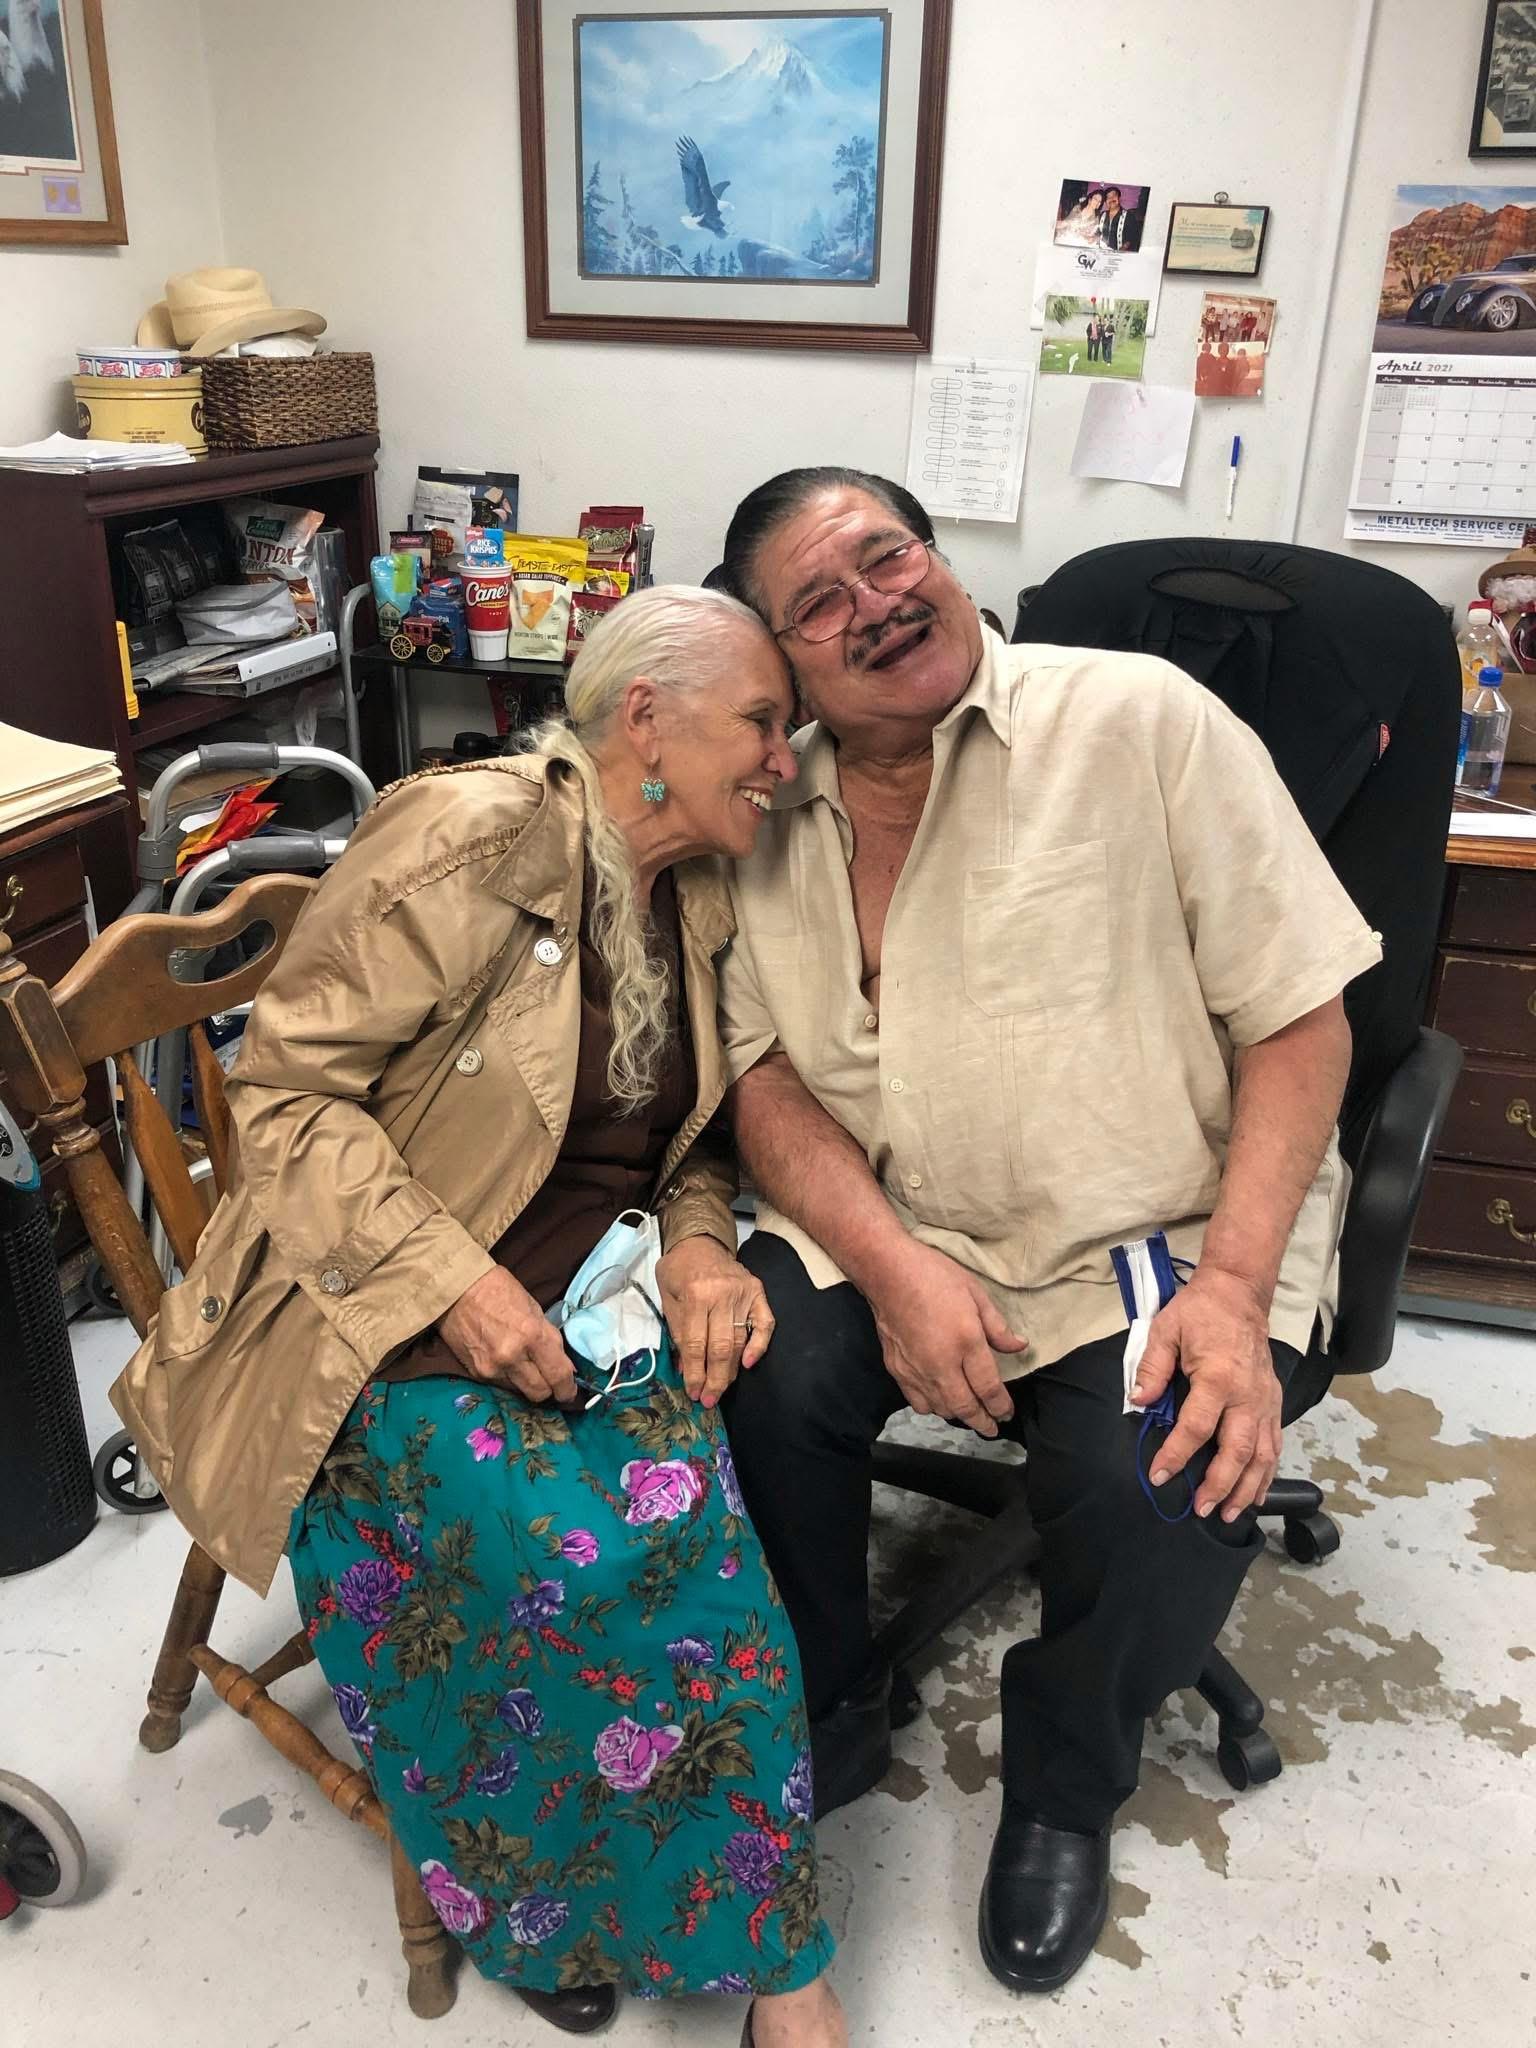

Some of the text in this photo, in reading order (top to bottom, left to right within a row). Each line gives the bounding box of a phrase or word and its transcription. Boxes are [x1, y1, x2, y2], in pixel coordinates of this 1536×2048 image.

[1377, 360, 1453, 373] April 2021
[1377, 515, 1448, 528] METALTECH
[1452, 519, 1503, 531] SERVICE
[470, 545, 498, 554] KRISPIES
[477, 539, 491, 547] RICE
[466, 581, 509, 606] Cane's
